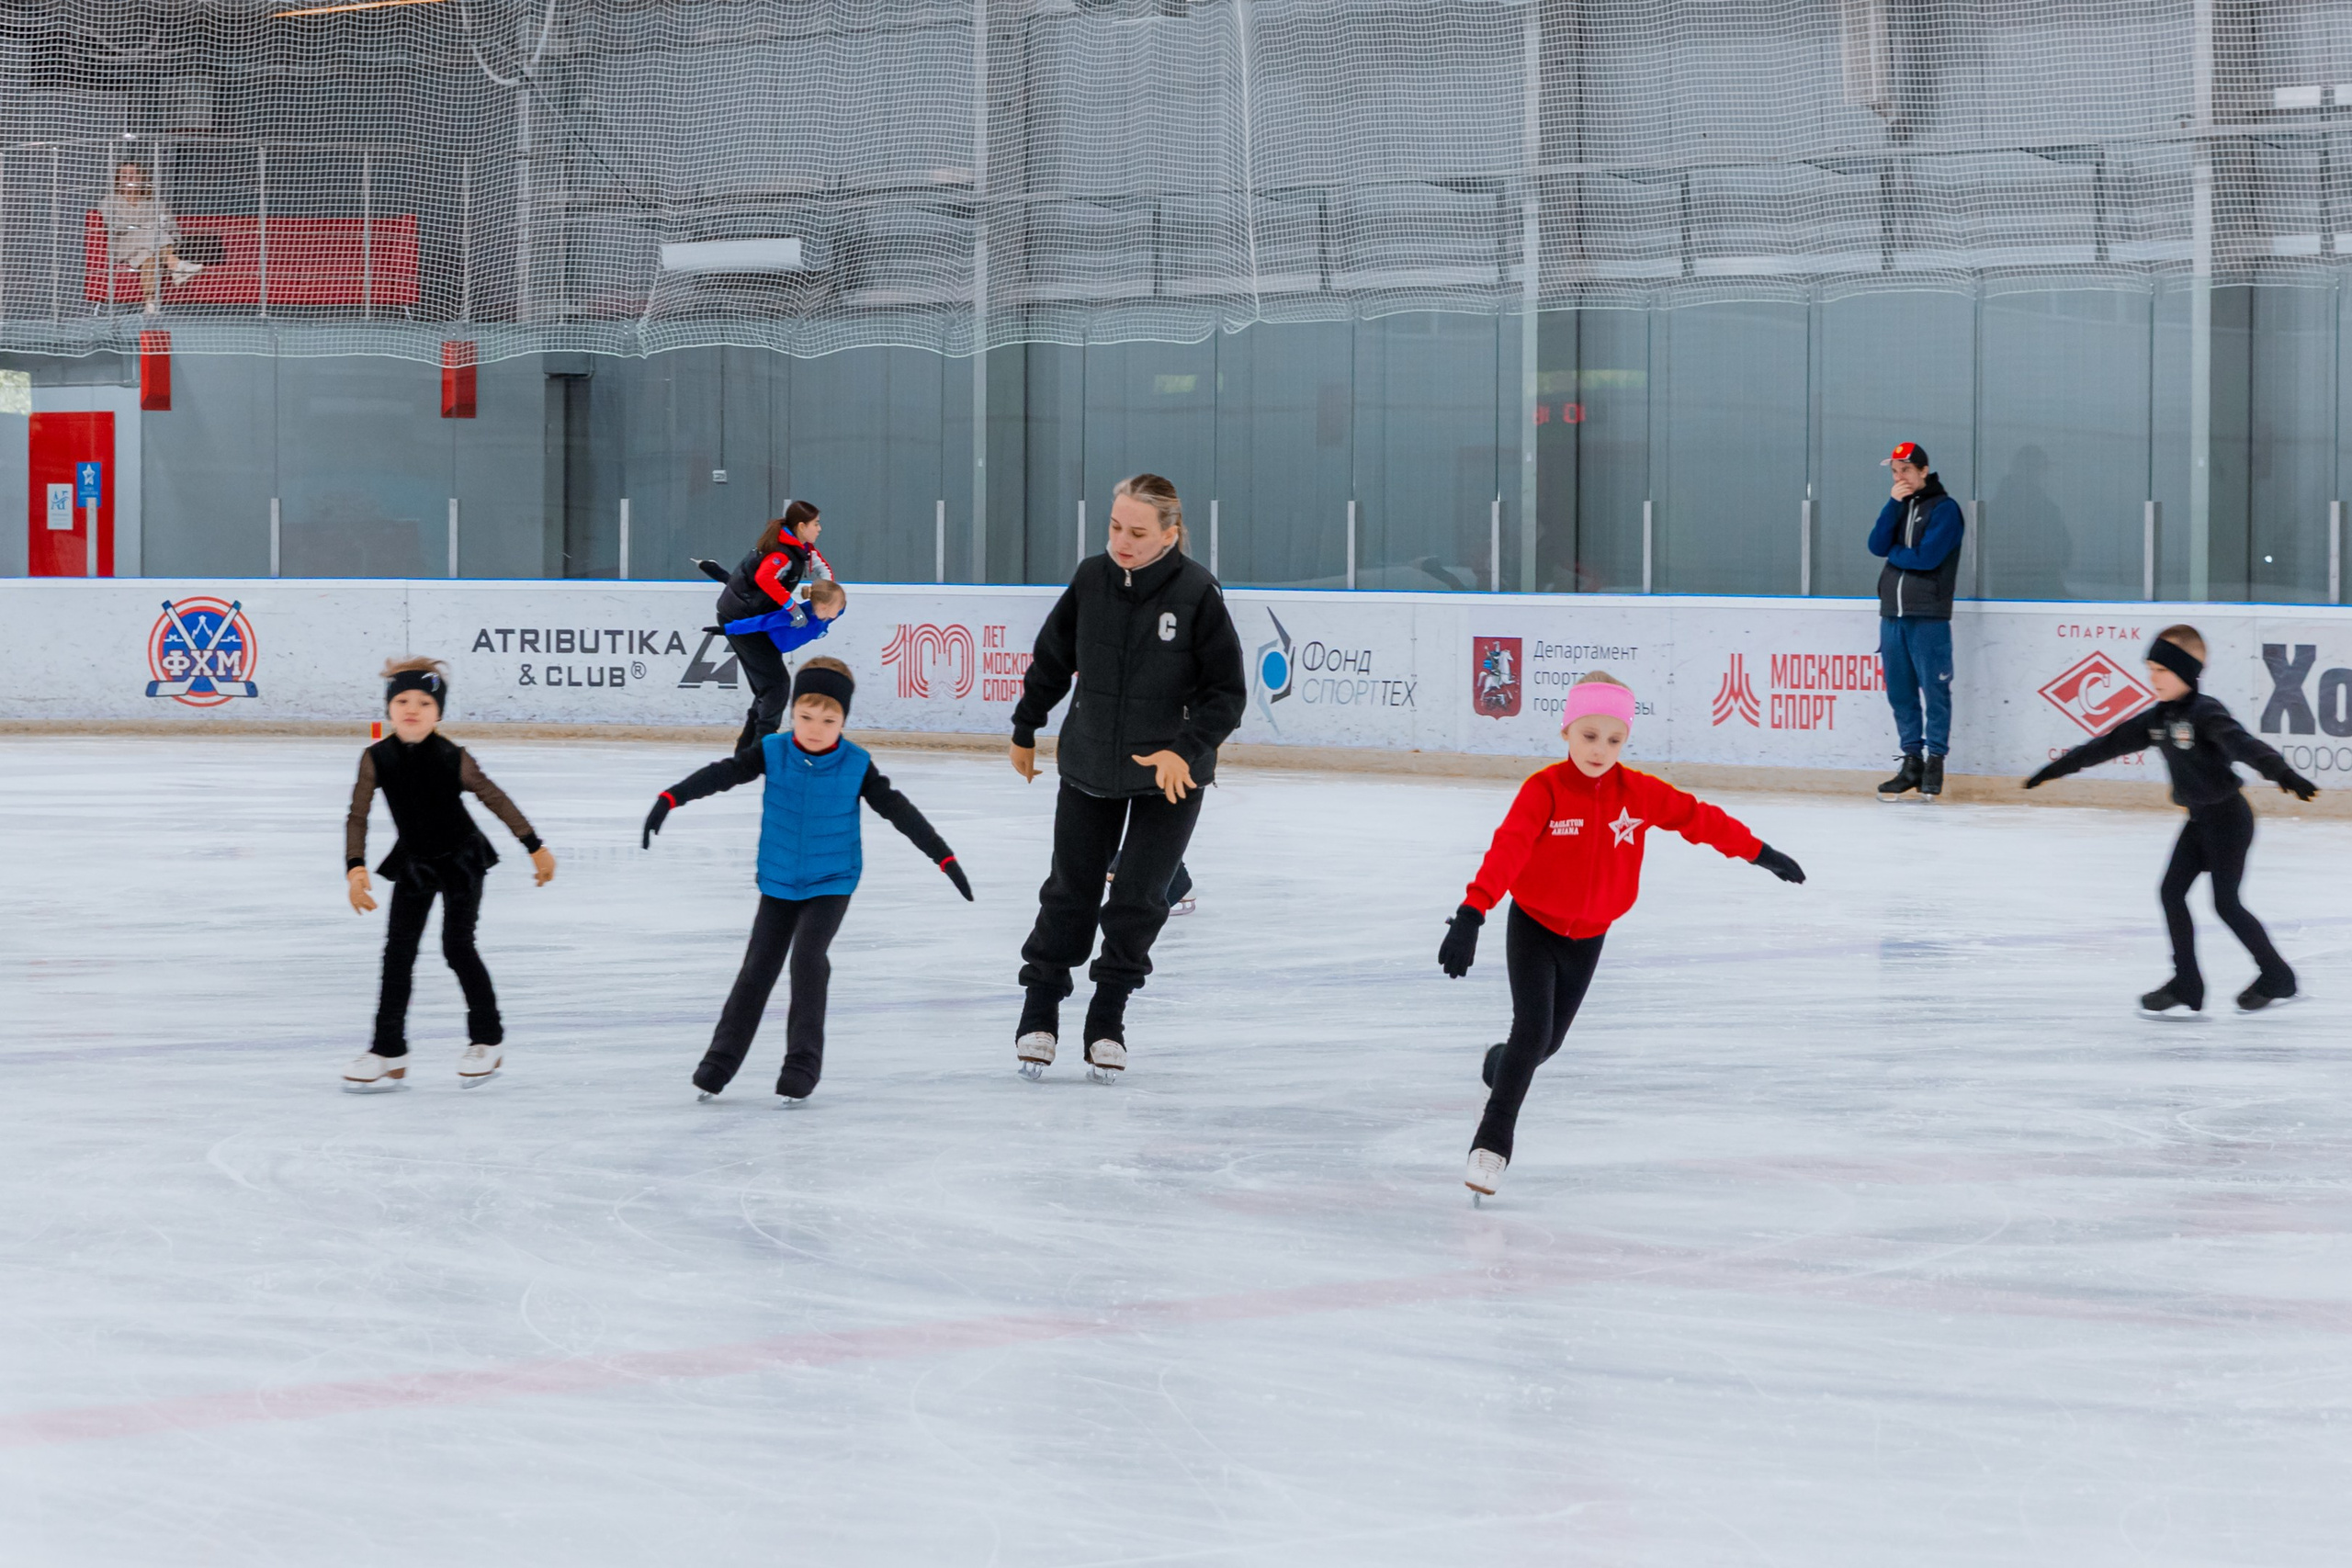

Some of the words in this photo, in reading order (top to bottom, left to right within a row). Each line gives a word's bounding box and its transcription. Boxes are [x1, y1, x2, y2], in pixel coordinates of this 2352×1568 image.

[471, 628, 688, 656] ATRIBUTIKA
[982, 626, 1007, 649] ЛЕТ
[2057, 624, 2142, 640] СПАРТАК
[161, 649, 243, 678] ФХМ
[1302, 641, 1373, 676] Фонд
[1532, 639, 1639, 664] Департамент
[518, 663, 538, 686] &
[1770, 653, 1887, 691] МОСКОВСК
[982, 678, 1025, 703] СПОРТ
[1302, 678, 1418, 707] СПОРТТЕХ
[1770, 694, 1837, 730] СПОРТ
